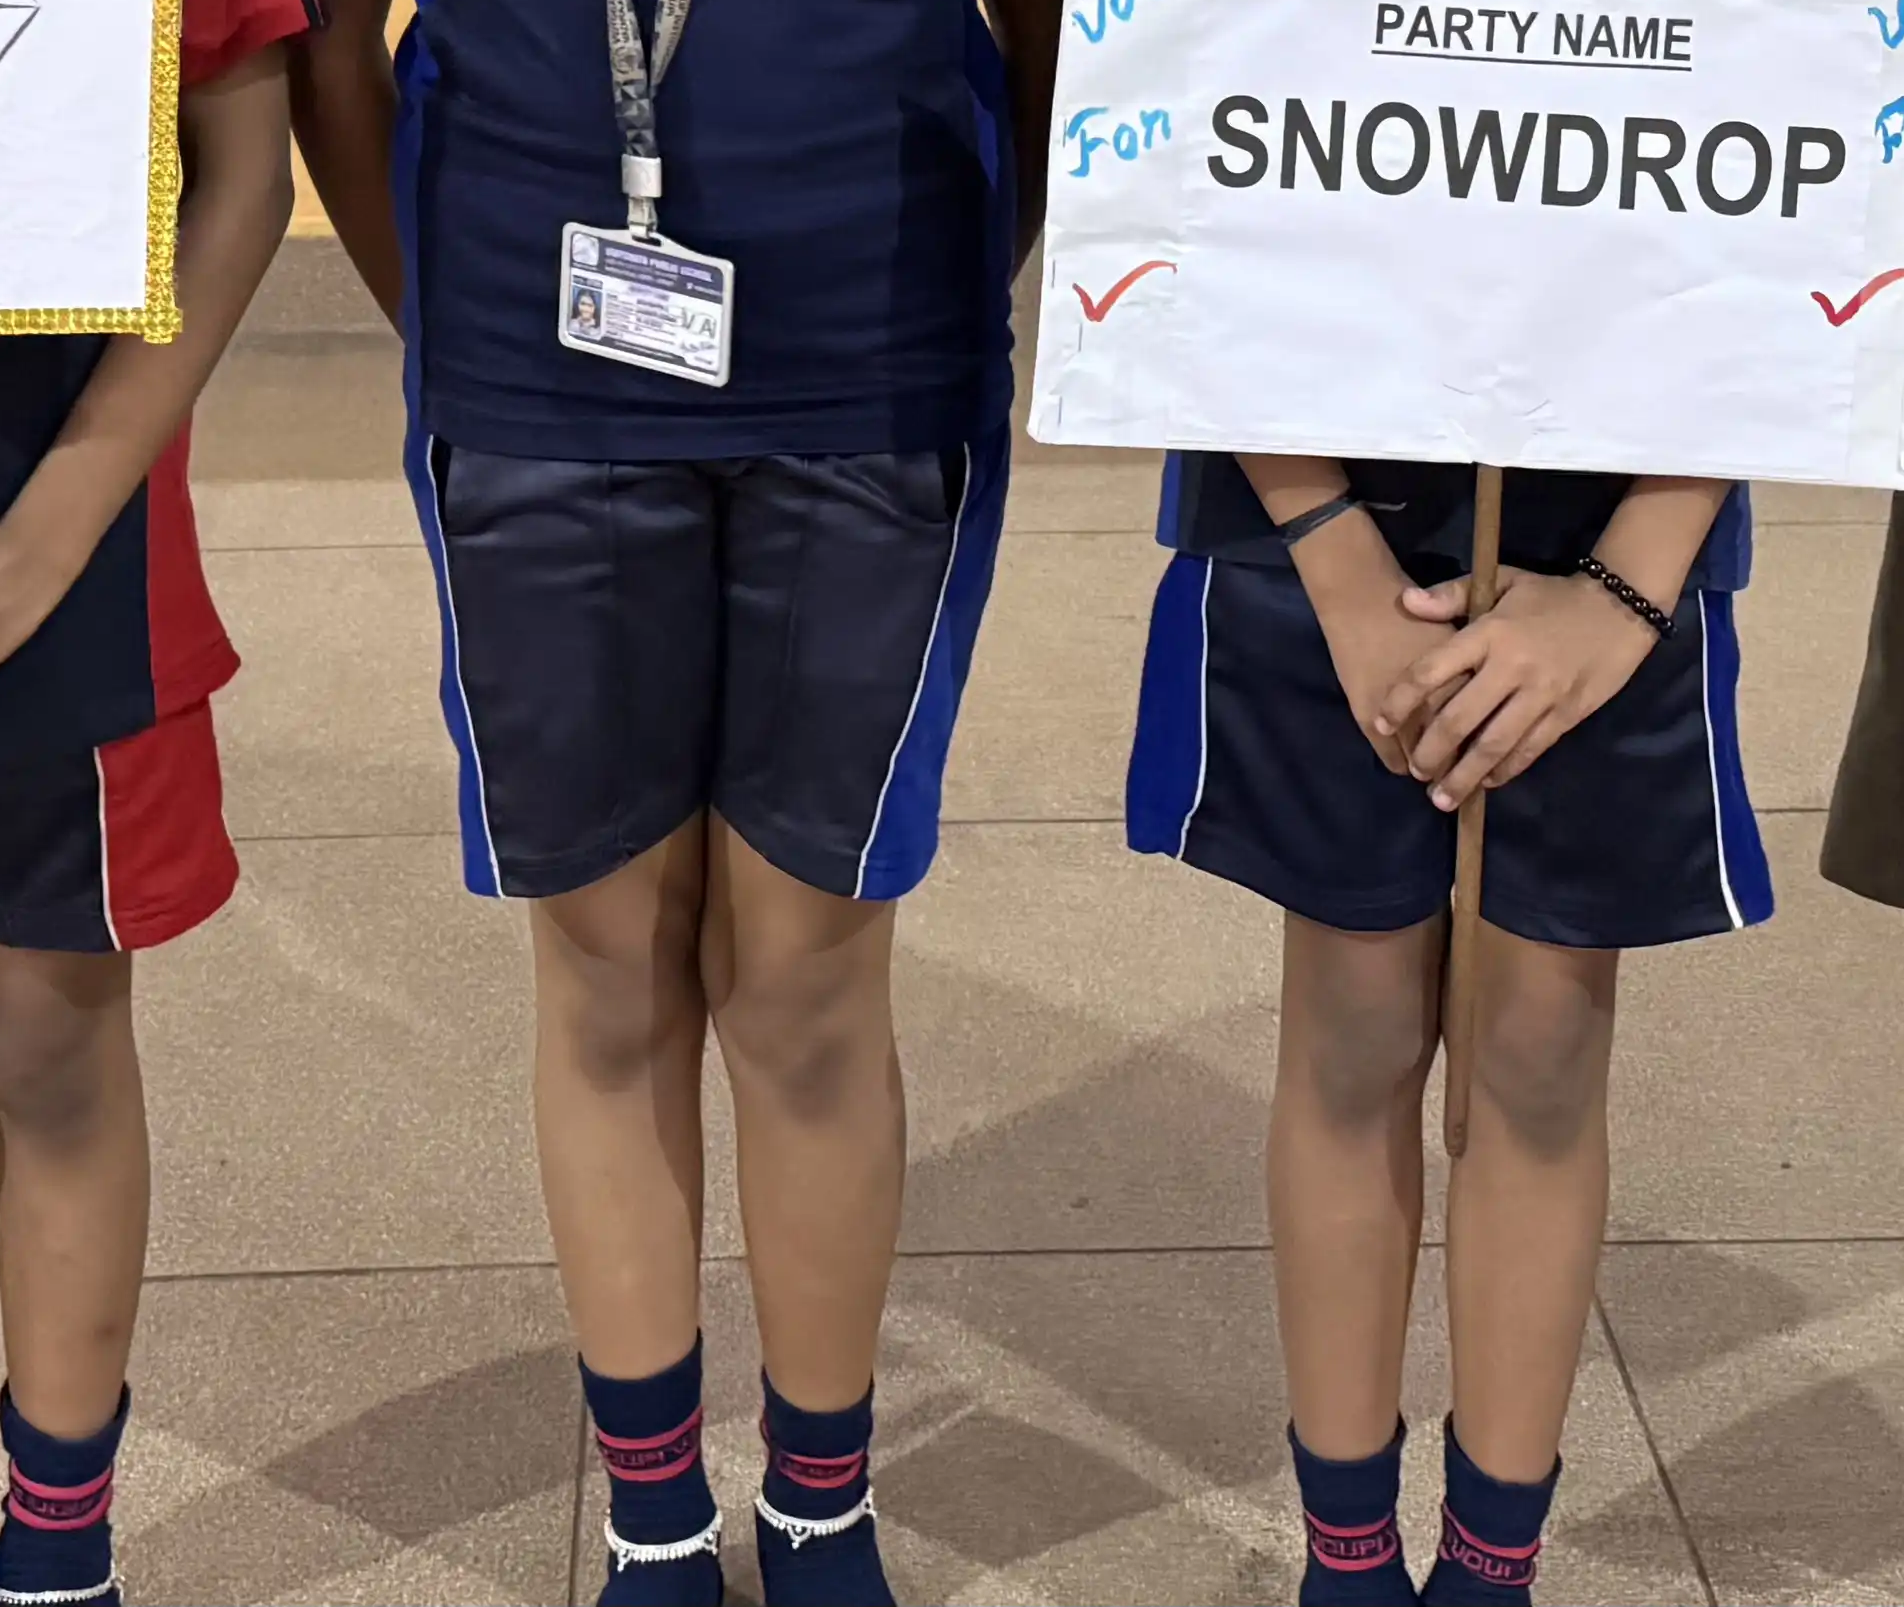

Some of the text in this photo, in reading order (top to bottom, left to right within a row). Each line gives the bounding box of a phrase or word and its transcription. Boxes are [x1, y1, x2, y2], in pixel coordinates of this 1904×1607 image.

[1375, 3, 1694, 62] PARTY NAME
[1207, 94, 1847, 219] SNOWDROP
